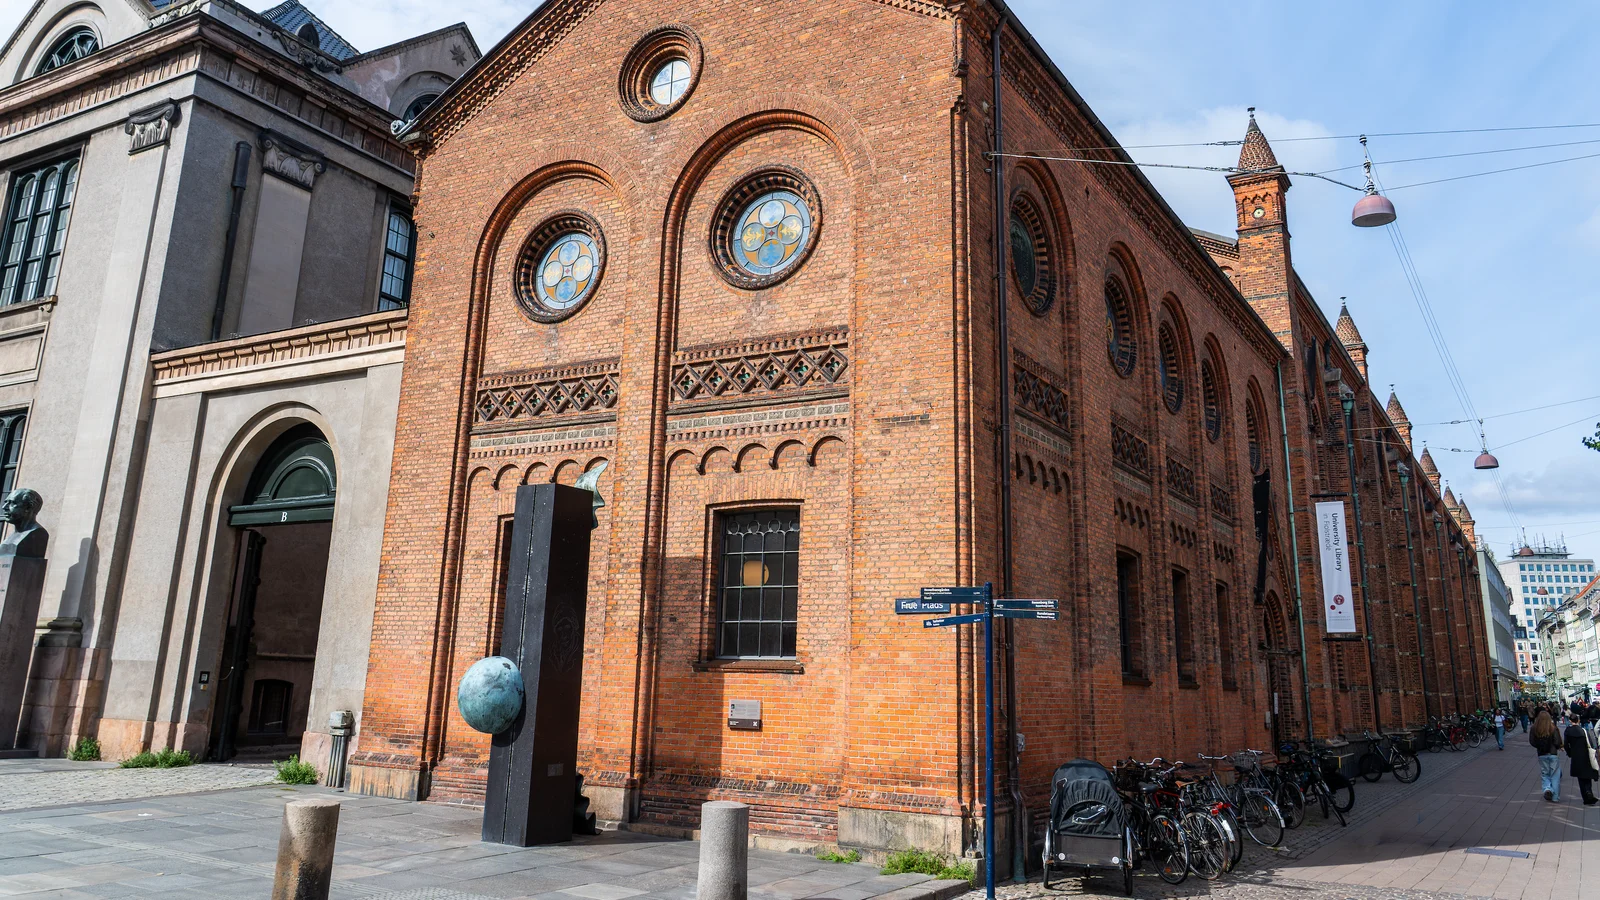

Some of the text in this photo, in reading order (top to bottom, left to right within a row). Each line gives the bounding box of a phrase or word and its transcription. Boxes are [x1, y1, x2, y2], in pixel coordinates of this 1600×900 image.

[280, 511, 288, 522] B
[1331, 513, 1340, 547] University
[901, 601, 918, 610] Frue
